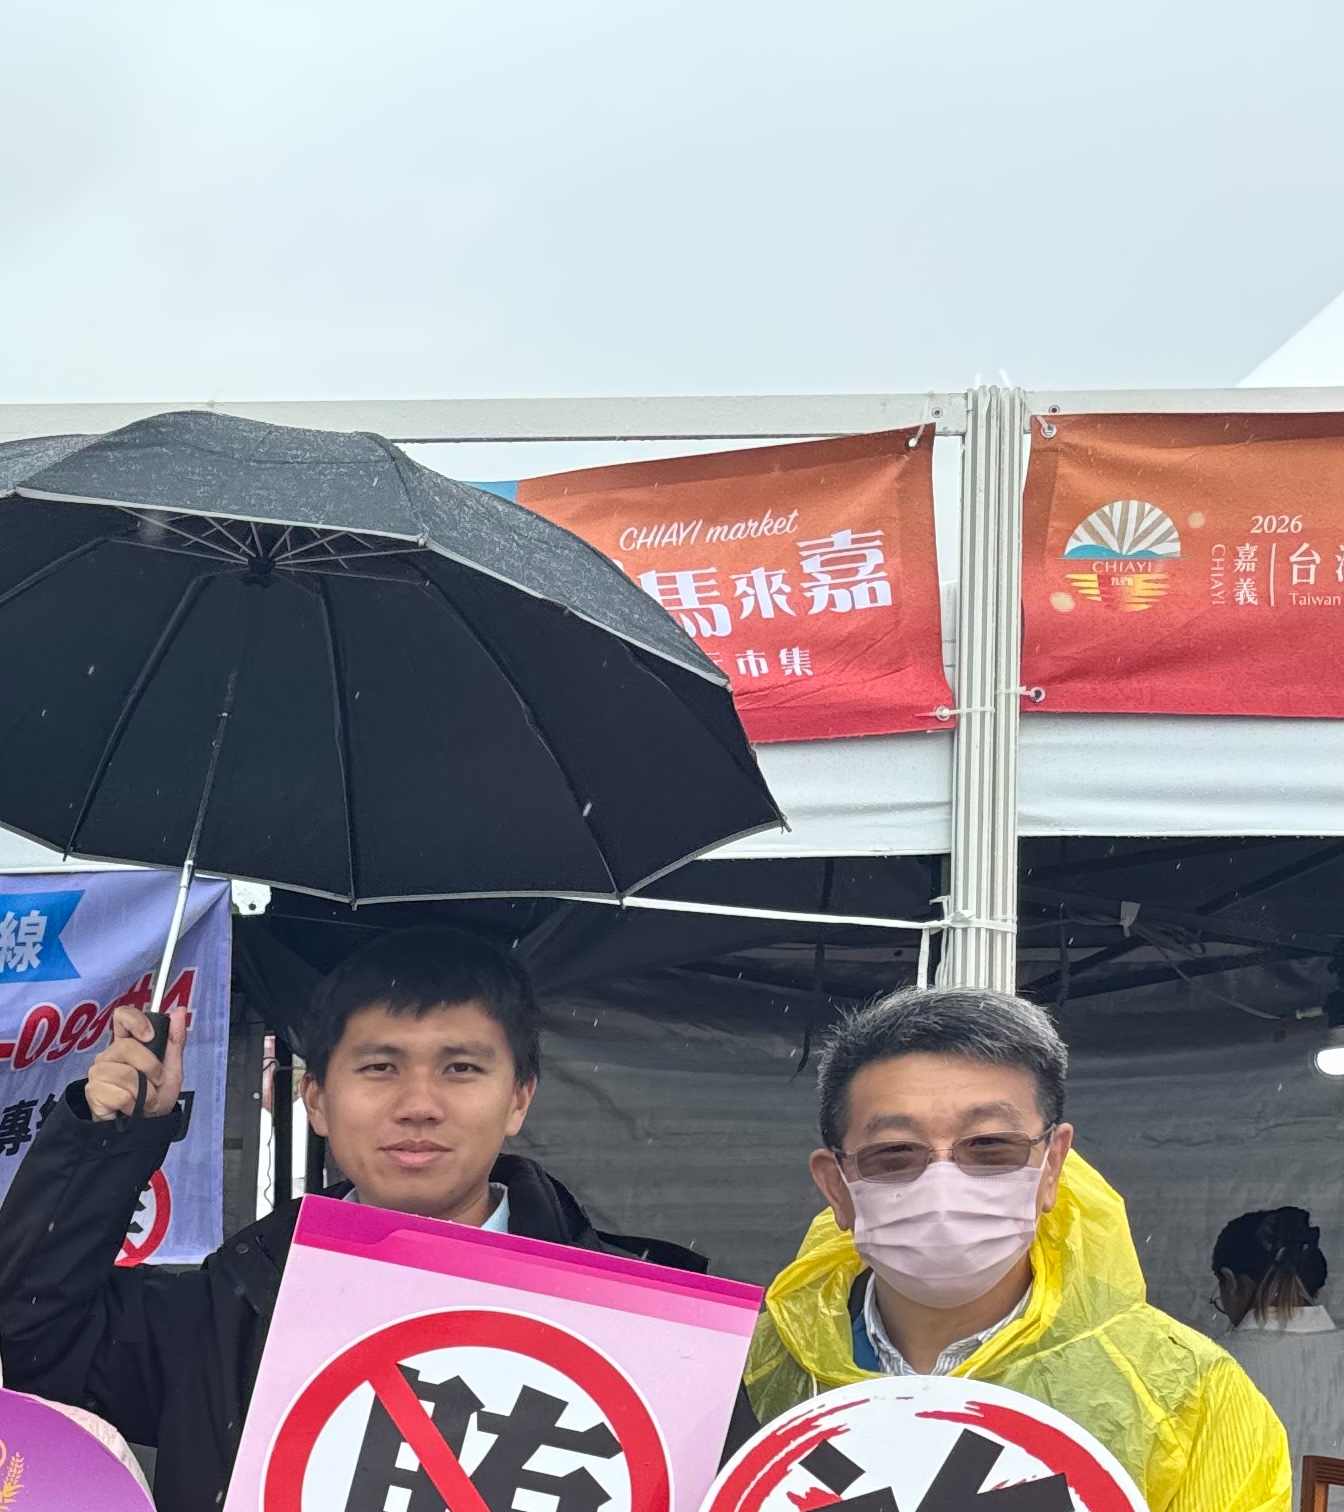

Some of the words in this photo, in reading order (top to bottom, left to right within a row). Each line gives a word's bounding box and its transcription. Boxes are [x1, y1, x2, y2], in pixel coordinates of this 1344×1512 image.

[619, 519, 703, 550] CHIAYI
[705, 509, 799, 543] market
[1250, 515, 1303, 534] 2026
[613, 529, 893, 637] 馬來嘉
[1092, 560, 1153, 573] CHIAYI
[1211, 544, 1226, 605] CHIAYI
[1234, 543, 1259, 606] 嘉義
[1289, 543, 1344, 585] 台
[1289, 592, 1341, 606] Taiwan
